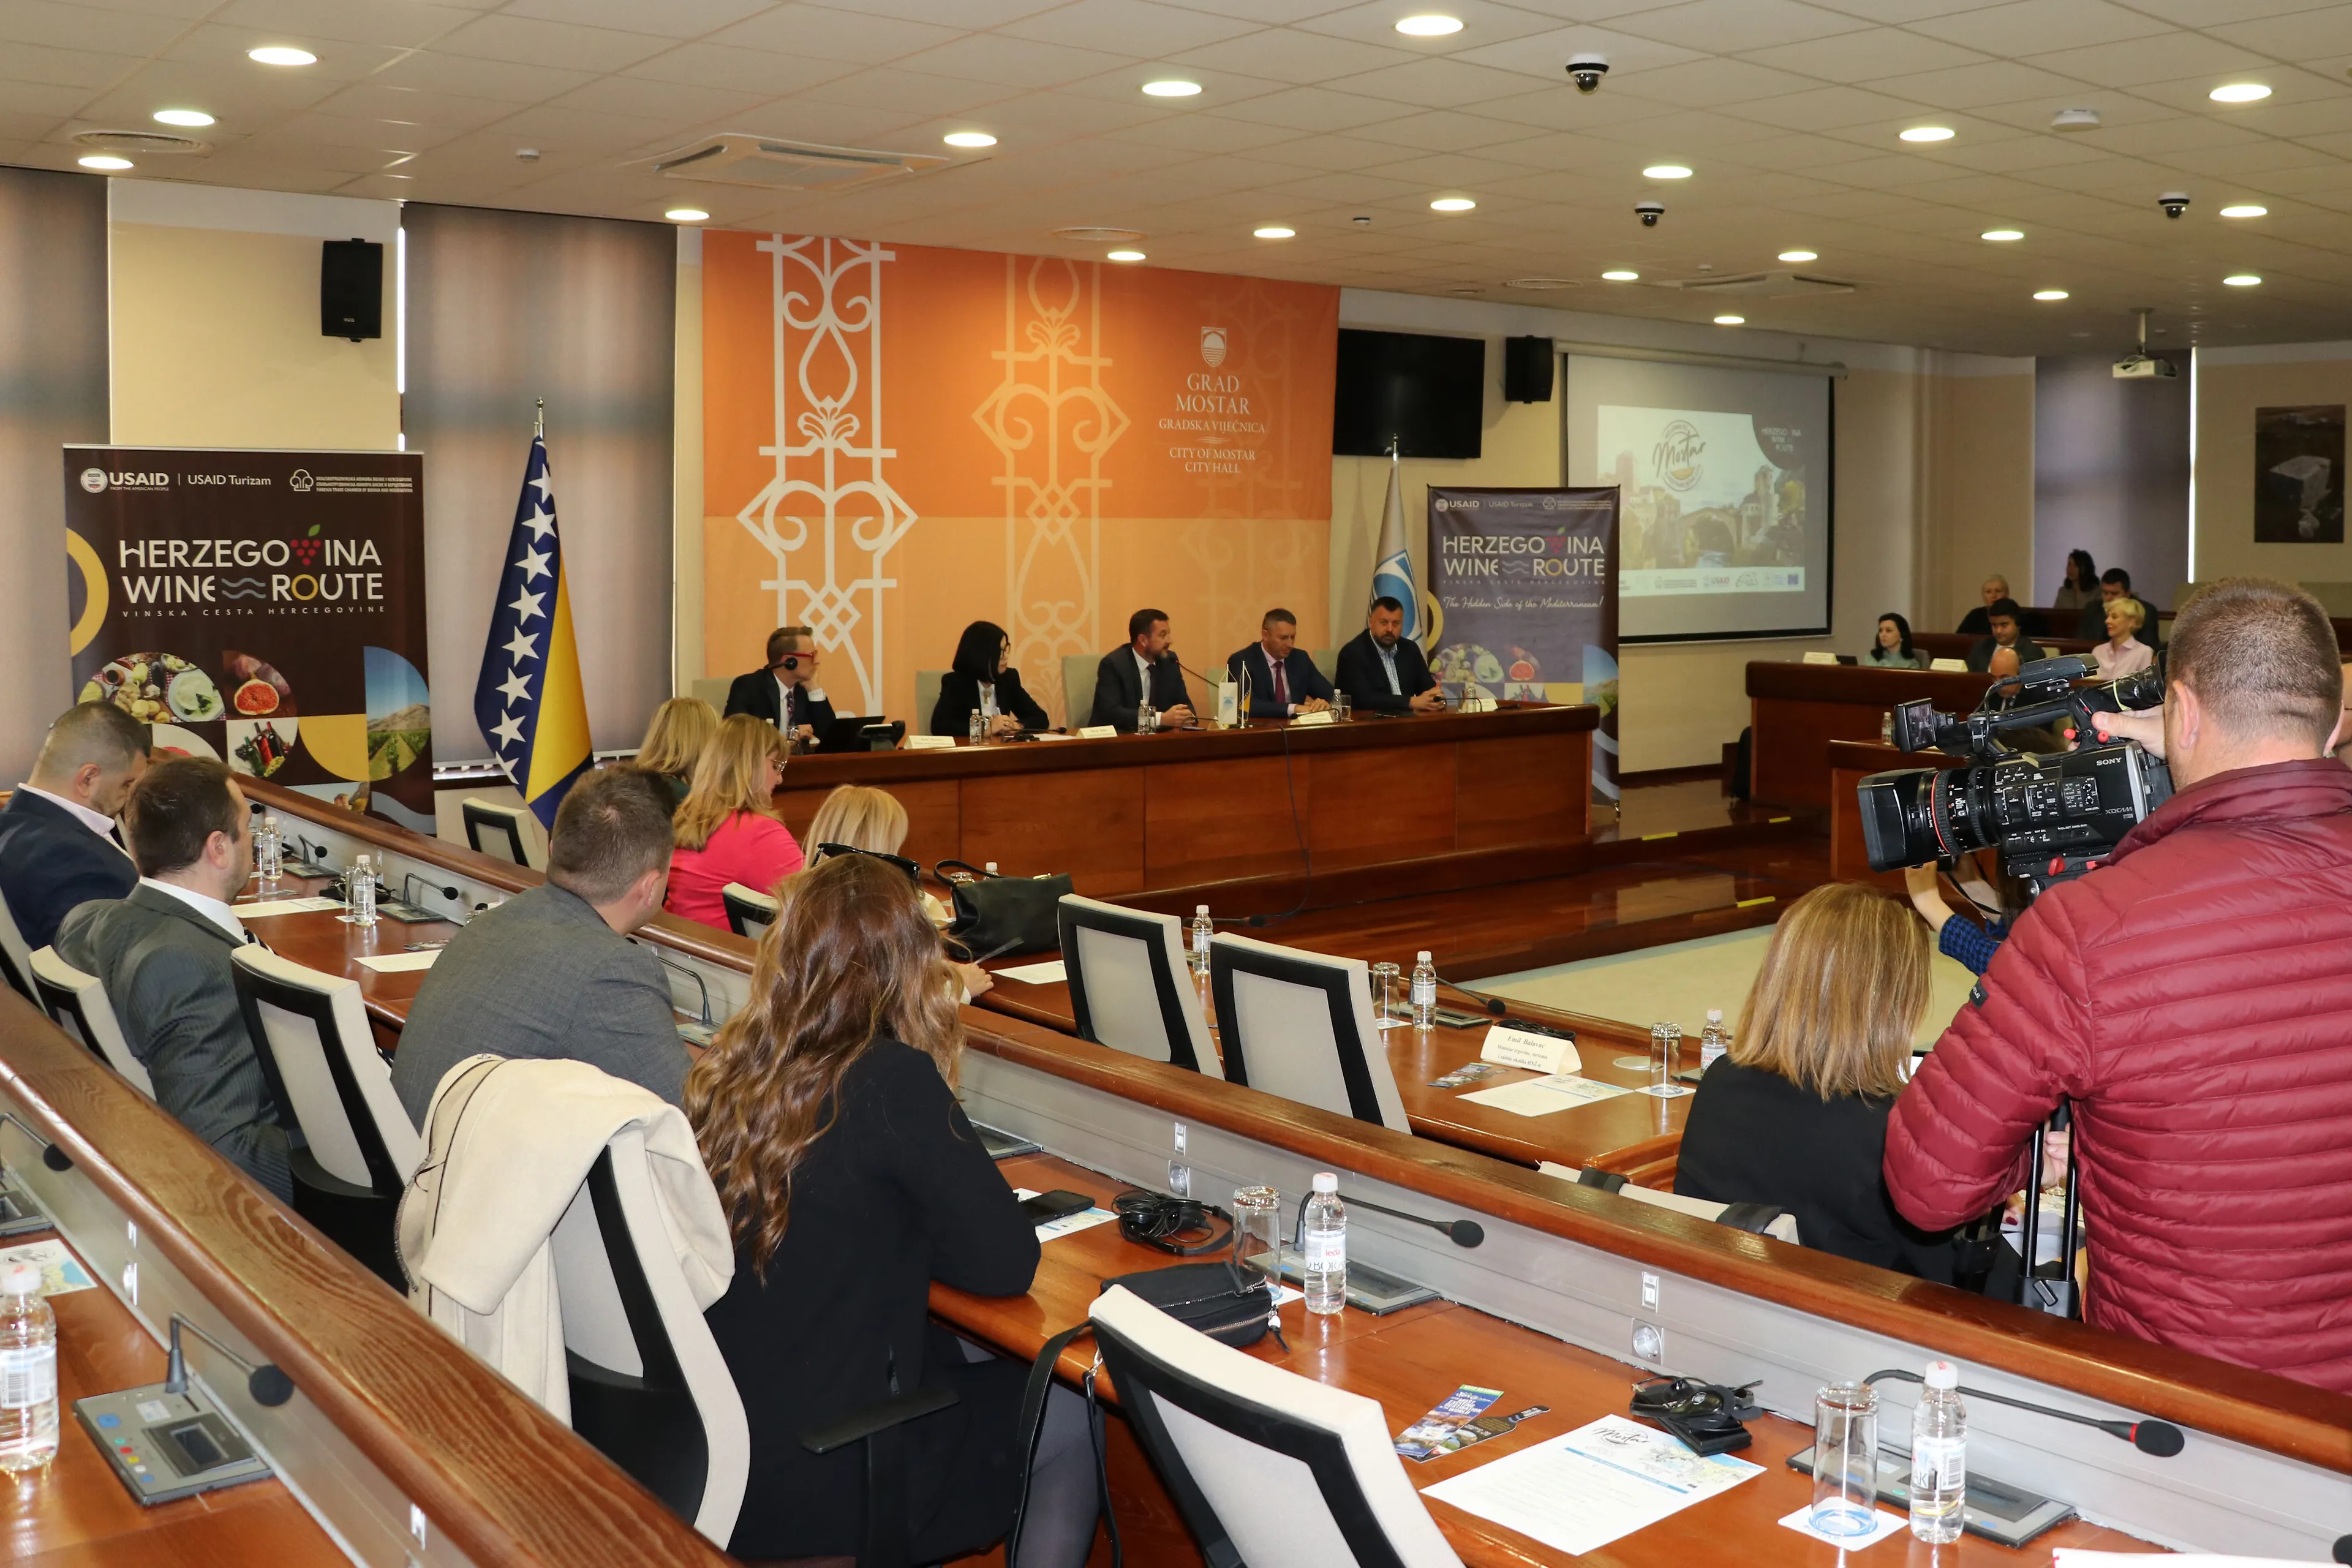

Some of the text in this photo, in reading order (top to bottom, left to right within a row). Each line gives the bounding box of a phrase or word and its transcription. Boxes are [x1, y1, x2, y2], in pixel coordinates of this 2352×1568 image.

[1187, 372, 1239, 393] GRAD
[1175, 394, 1251, 415] MOSTAR
[1159, 418, 1210, 431] GRADSKA
[1169, 447, 1256, 460] CITY OF MOSTAR
[1185, 462, 1240, 473] CITY HALL
[109, 472, 169, 486] USAID
[188, 473, 271, 486] USAID Turizam
[1449, 500, 1480, 508] USAID
[1443, 558, 1605, 576] WINE ROUTE
[122, 573, 383, 603] WINE ROUTE
[268, 605, 385, 615] HERCEGOVINE
[1444, 596, 1460, 609] The
[1461, 597, 1491, 608] Hidden
[1494, 597, 1513, 609] Side
[1515, 600, 1524, 611] of
[1525, 598, 1538, 608] the
[2096, 757, 2122, 766] SONY
[1325, 1248, 1341, 1257] leda
